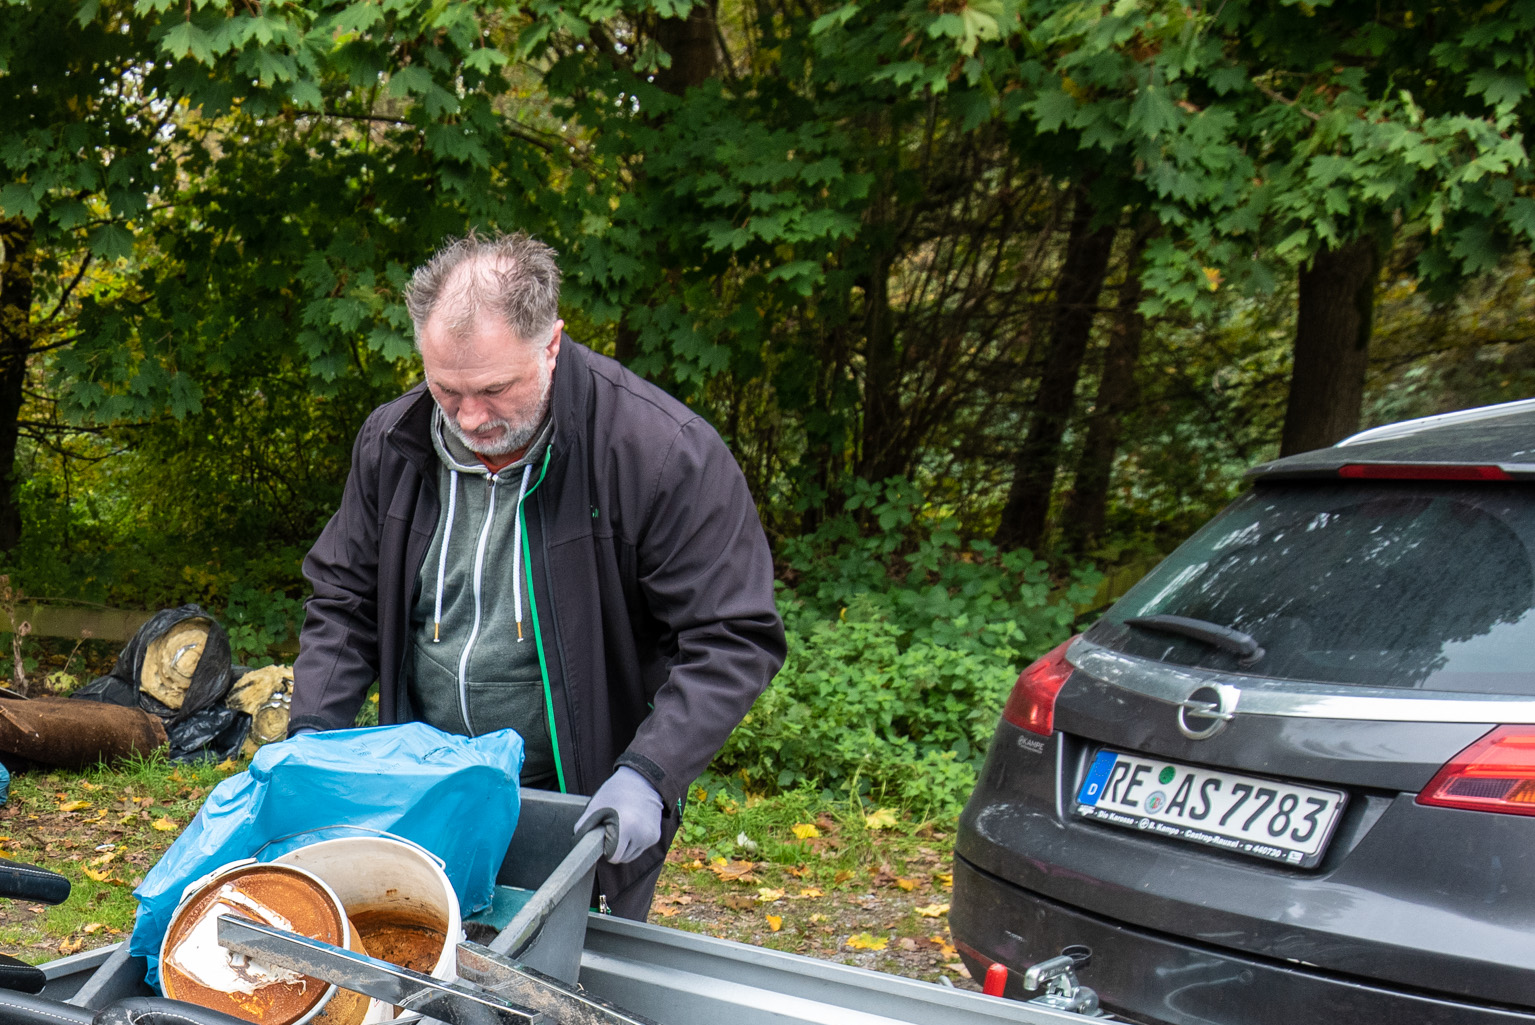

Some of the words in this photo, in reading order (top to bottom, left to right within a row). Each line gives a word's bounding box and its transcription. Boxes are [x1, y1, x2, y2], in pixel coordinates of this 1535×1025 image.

[1087, 783, 1099, 796] D
[1100, 760, 1153, 808] RE
[1164, 773, 1221, 821] AS
[1219, 783, 1328, 842] 7783
[1184, 829, 1240, 849] Castrop-Rauxel
